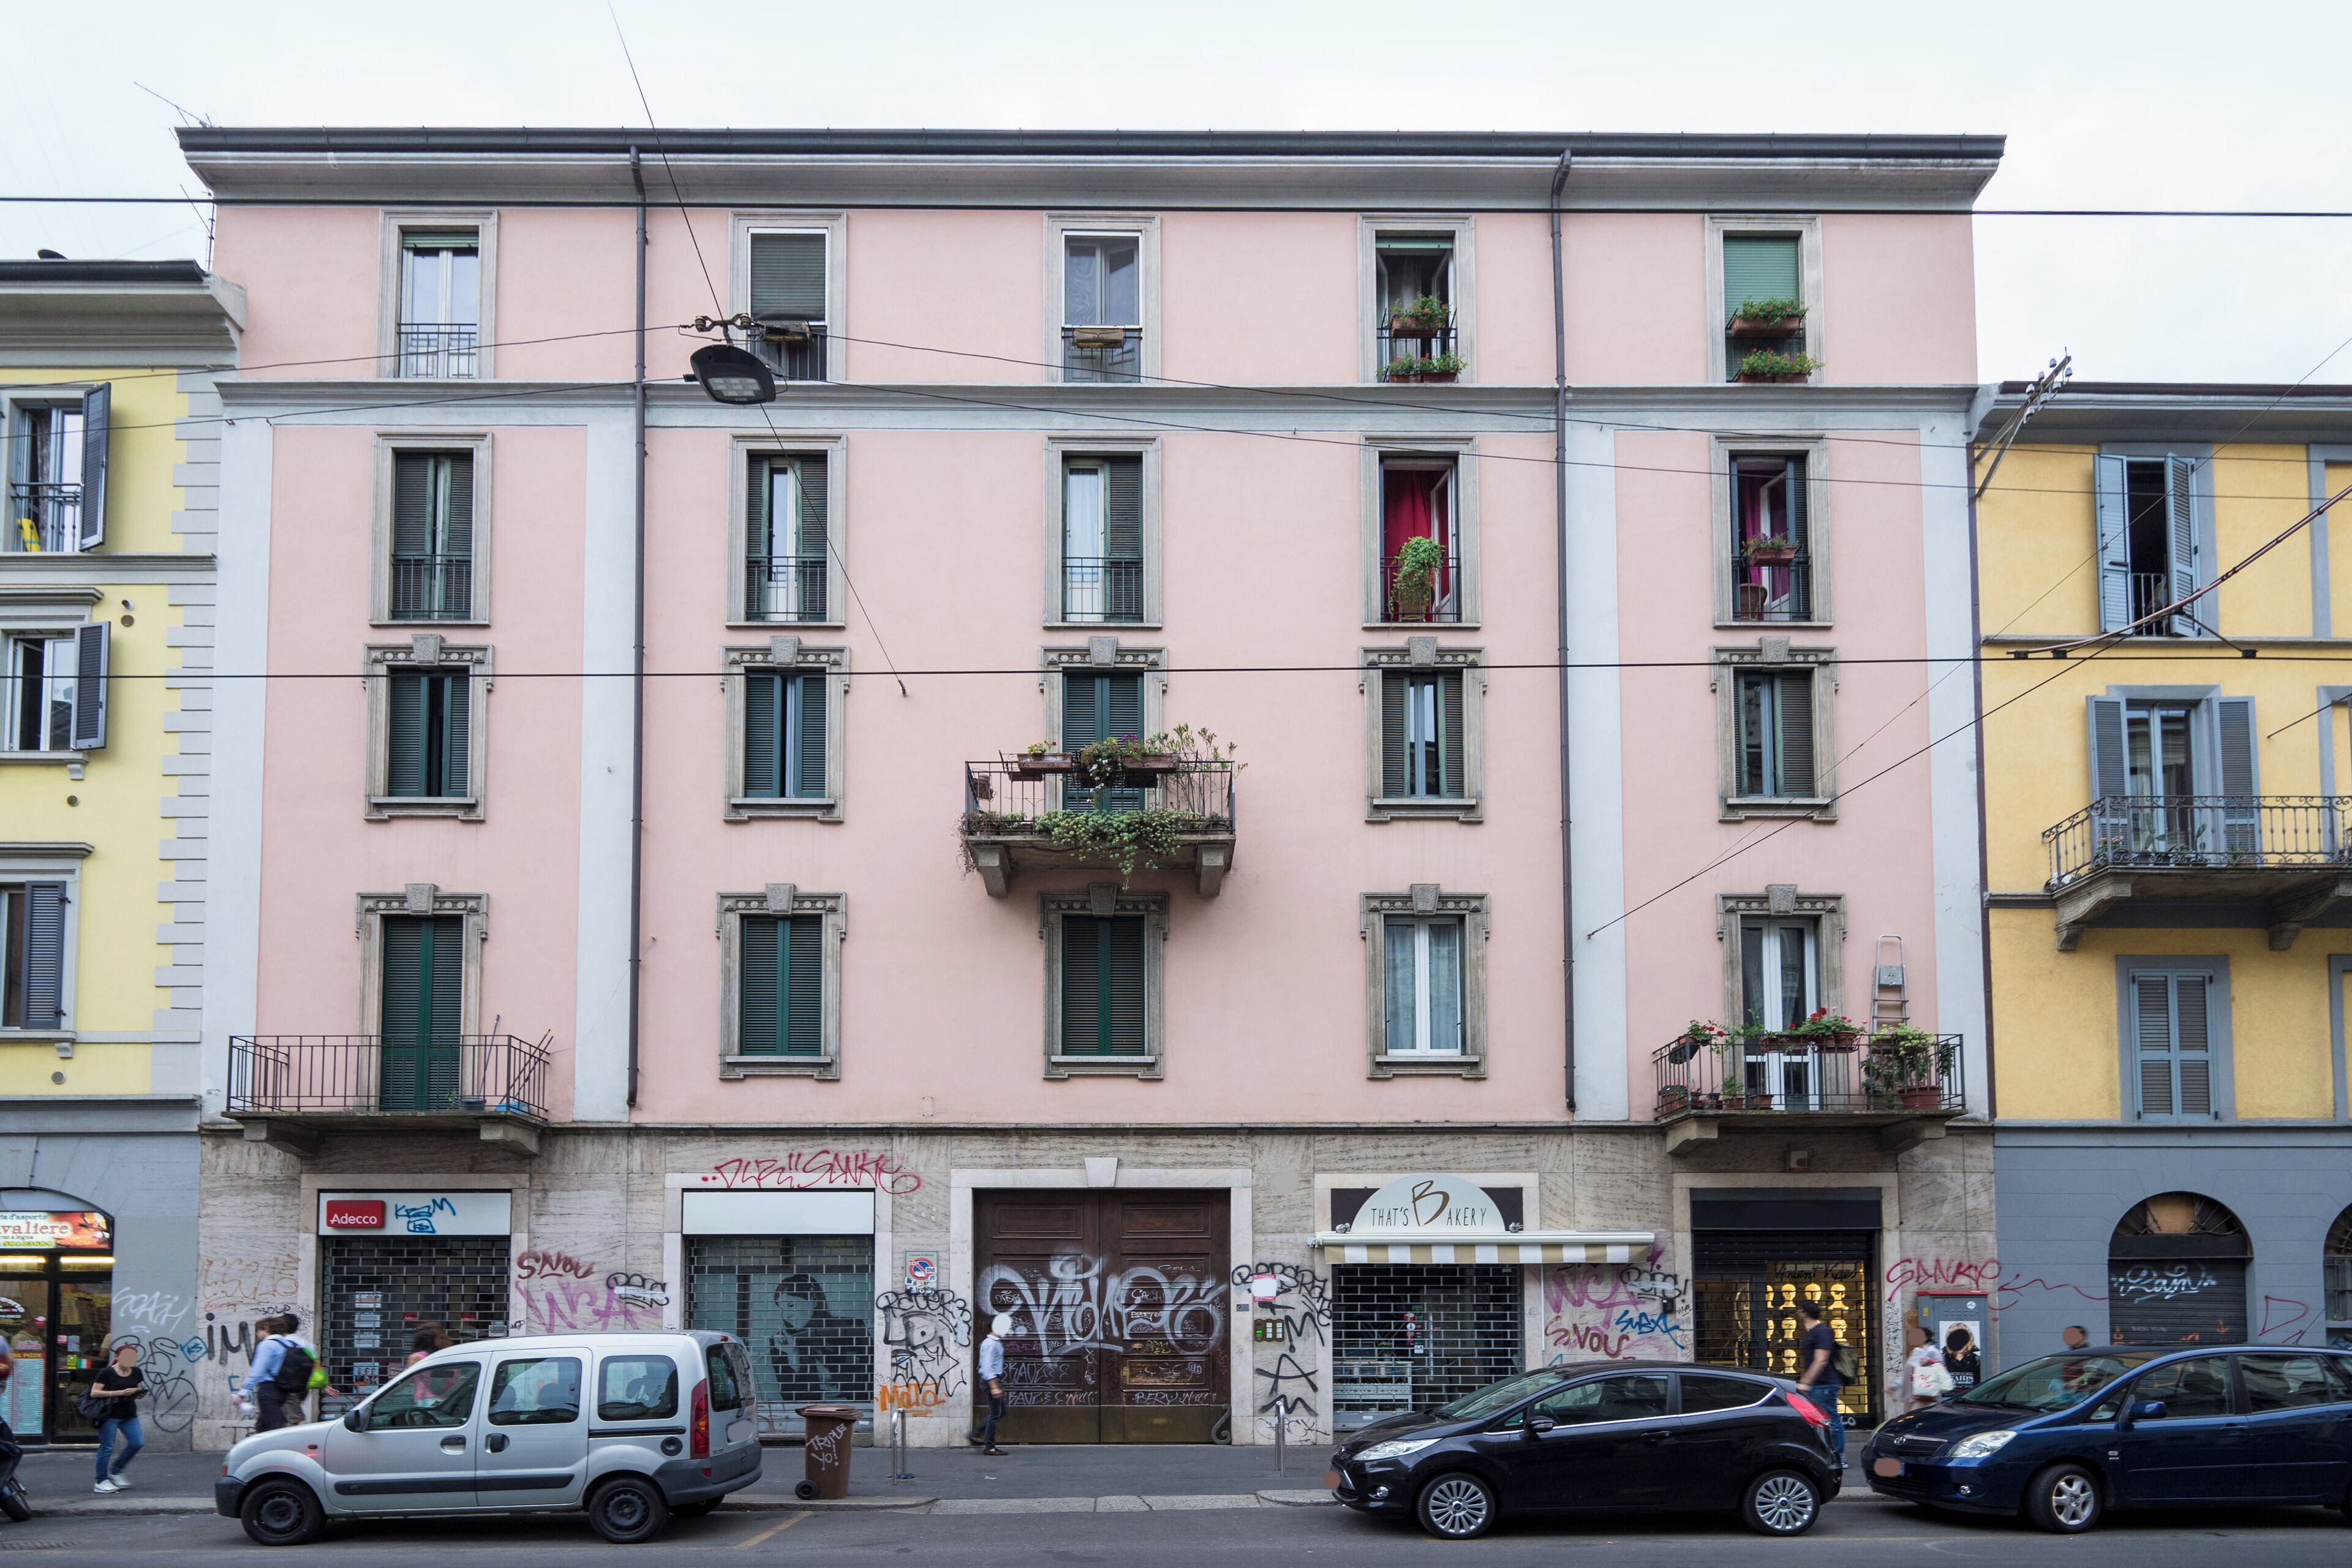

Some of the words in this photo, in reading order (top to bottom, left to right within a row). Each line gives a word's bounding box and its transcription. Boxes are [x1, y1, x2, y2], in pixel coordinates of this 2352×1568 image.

[330, 1213, 377, 1224] Adecco
[1371, 1207, 1409, 1226] THAT'S
[0, 1221, 69, 1235] valiere
